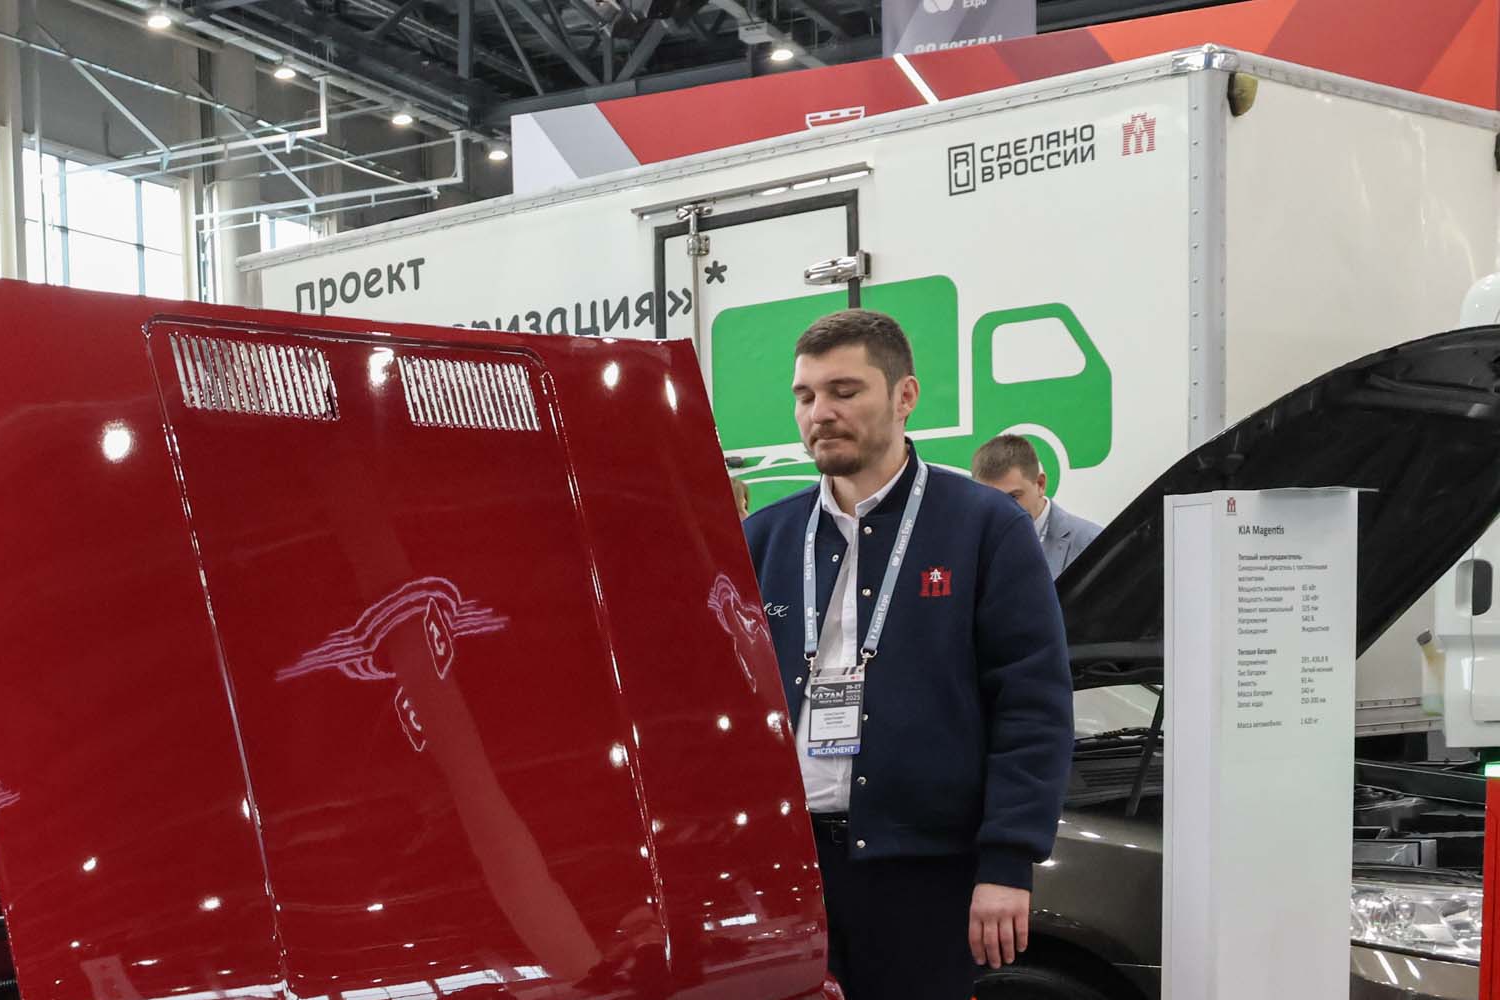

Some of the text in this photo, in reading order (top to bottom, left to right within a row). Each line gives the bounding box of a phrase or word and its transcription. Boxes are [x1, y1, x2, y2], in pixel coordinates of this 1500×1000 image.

[980, 124, 1095, 163] СДЕЛАНО
[296, 257, 425, 316] проект
[1238, 525, 1284, 536] KIA Magentis
[811, 690, 844, 700] KAZAN
[811, 746, 855, 756] ЭКСПОНЕНТ
